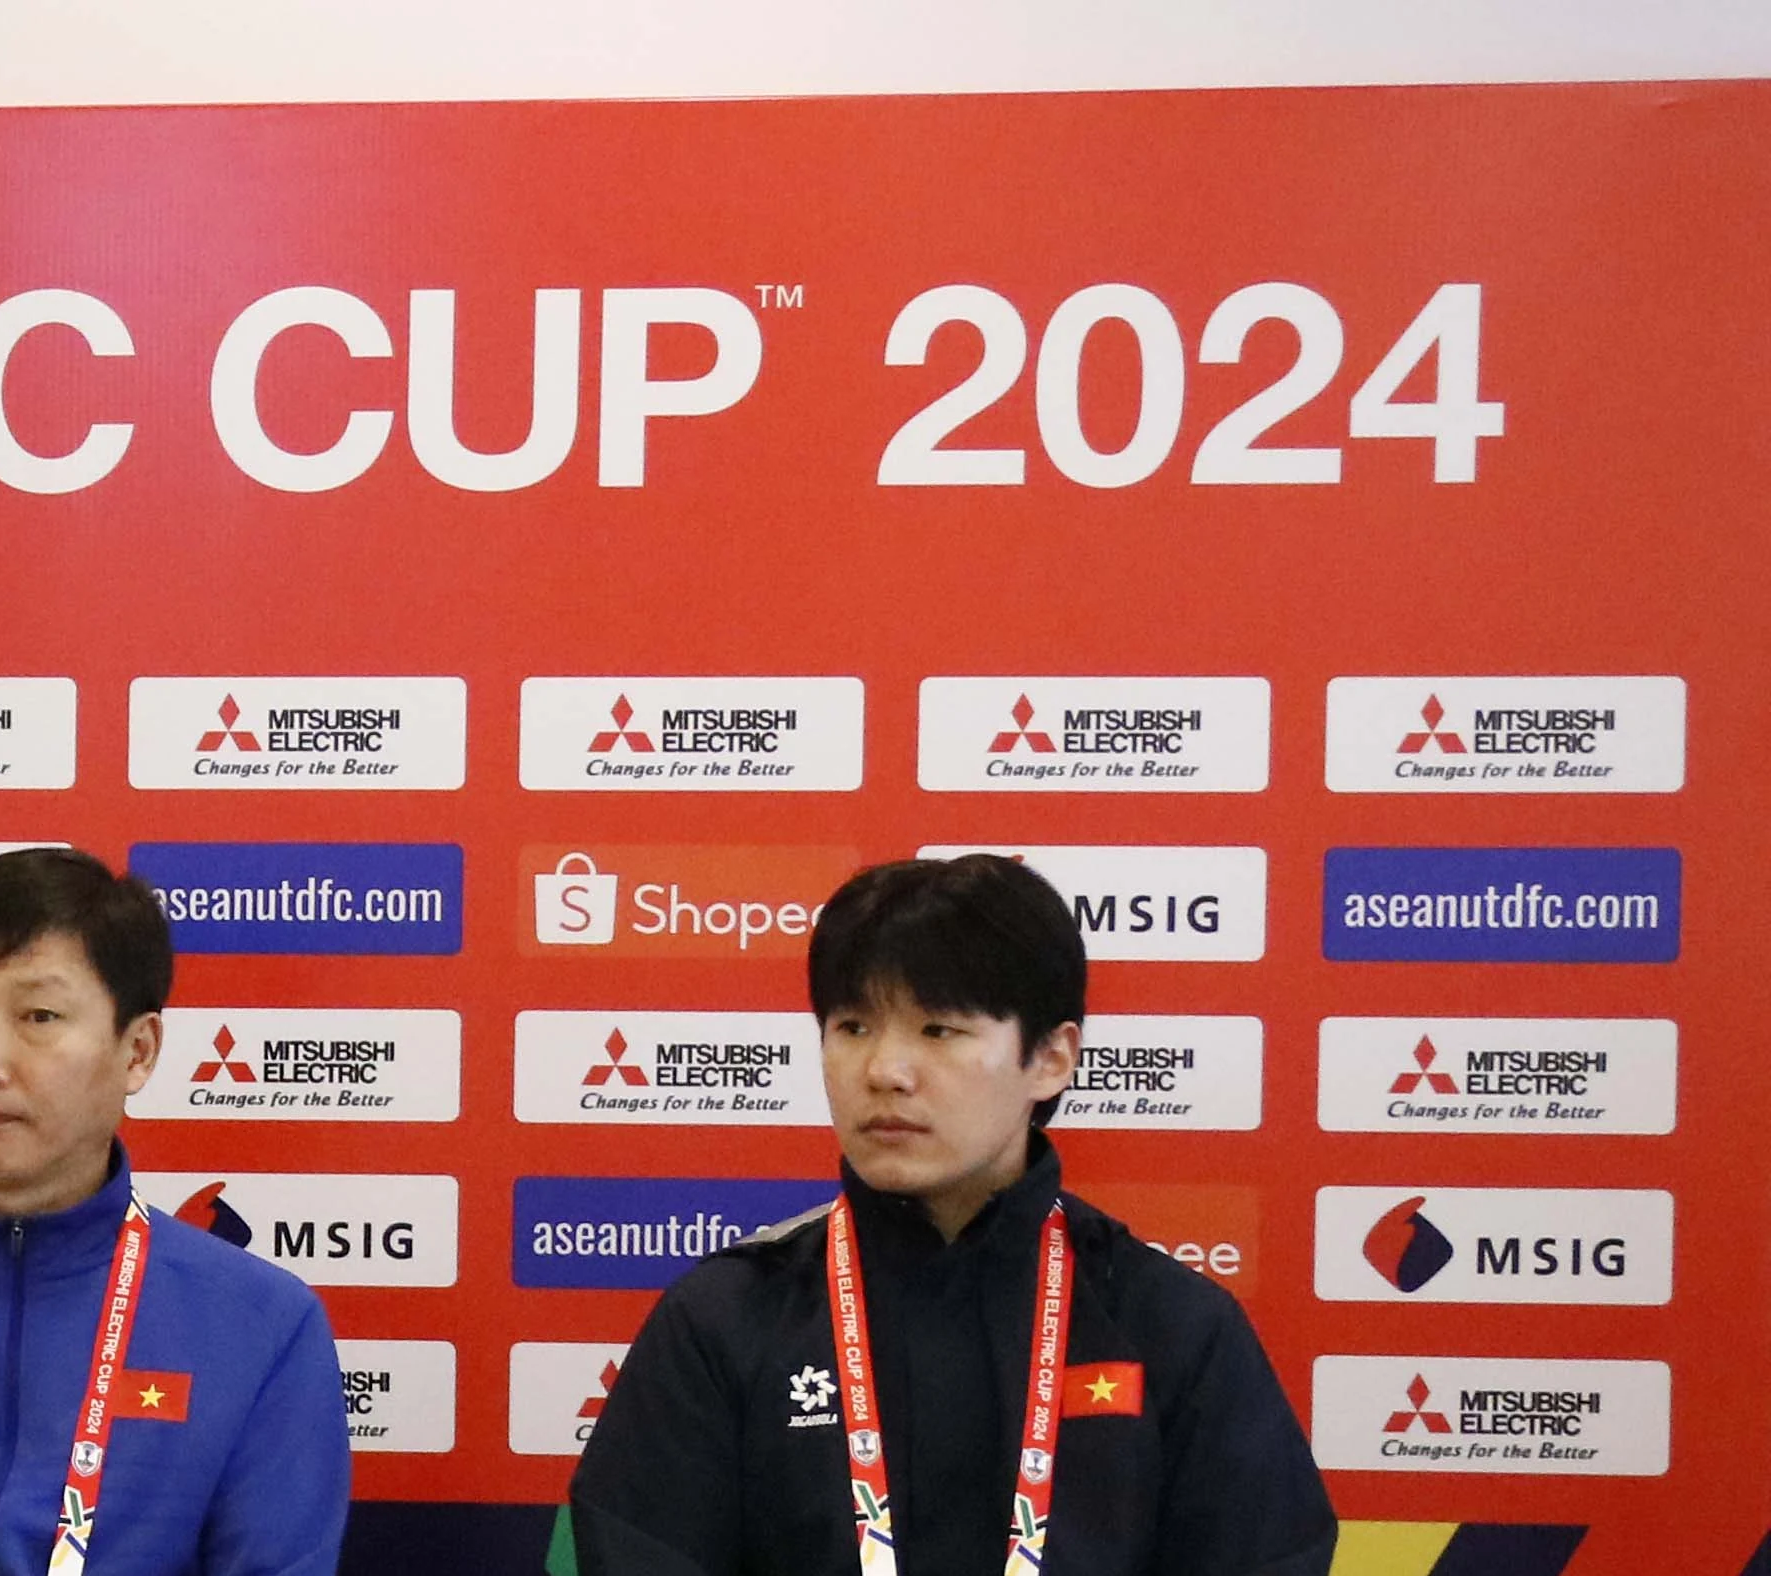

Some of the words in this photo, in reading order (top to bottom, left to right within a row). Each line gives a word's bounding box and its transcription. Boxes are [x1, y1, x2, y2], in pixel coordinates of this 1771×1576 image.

[211, 286, 762, 492] CUP
[878, 282, 1504, 488] 2024
[663, 710, 796, 730] MITSUBISHI
[1475, 710, 1614, 731] MITSUBISHI
[663, 732, 777, 752] ELECTRIC
[1475, 733, 1595, 753] ELECTRIC
[586, 759, 664, 779] Changes
[669, 762, 698, 777] for
[703, 762, 731, 776] the
[737, 759, 795, 776] Better
[1395, 761, 1475, 781] Changes
[1481, 763, 1512, 779] for
[1517, 763, 1547, 777] the
[1553, 760, 1613, 777] Better
[633, 884, 824, 949] Shope
[1077, 896, 1218, 932] MSIG
[1345, 883, 1657, 928] aseanutdfc.com
[264, 1040, 394, 1061] MITSUBISHI
[264, 1063, 376, 1083] ELECTRIC
[189, 1089, 266, 1108] Changes
[270, 1092, 298, 1107] for
[304, 1092, 331, 1106] the
[337, 1090, 393, 1106] Better
[273, 1222, 412, 1259] MSIG
[1478, 1238, 1624, 1276] MSIG
[837, 1277, 859, 1344] ELECTRIC
[102, 1296, 127, 1361] ELECTRIC
[1040, 1299, 1059, 1366] ELECTRIC
[96, 1364, 112, 1394] CUP
[846, 1348, 863, 1379] CUP
[1037, 1368, 1054, 1402] CUP
[86, 1398, 105, 1435] 2024
[850, 1384, 869, 1422] 2024
[1461, 1391, 1600, 1413] MITSUBISHI
[1032, 1406, 1049, 1441] 2024
[1461, 1414, 1580, 1436] ELECTRIC
[1381, 1439, 1462, 1460] Changes
[1467, 1443, 1497, 1459] for
[1503, 1444, 1531, 1458] the
[1538, 1442, 1599, 1459] Better
